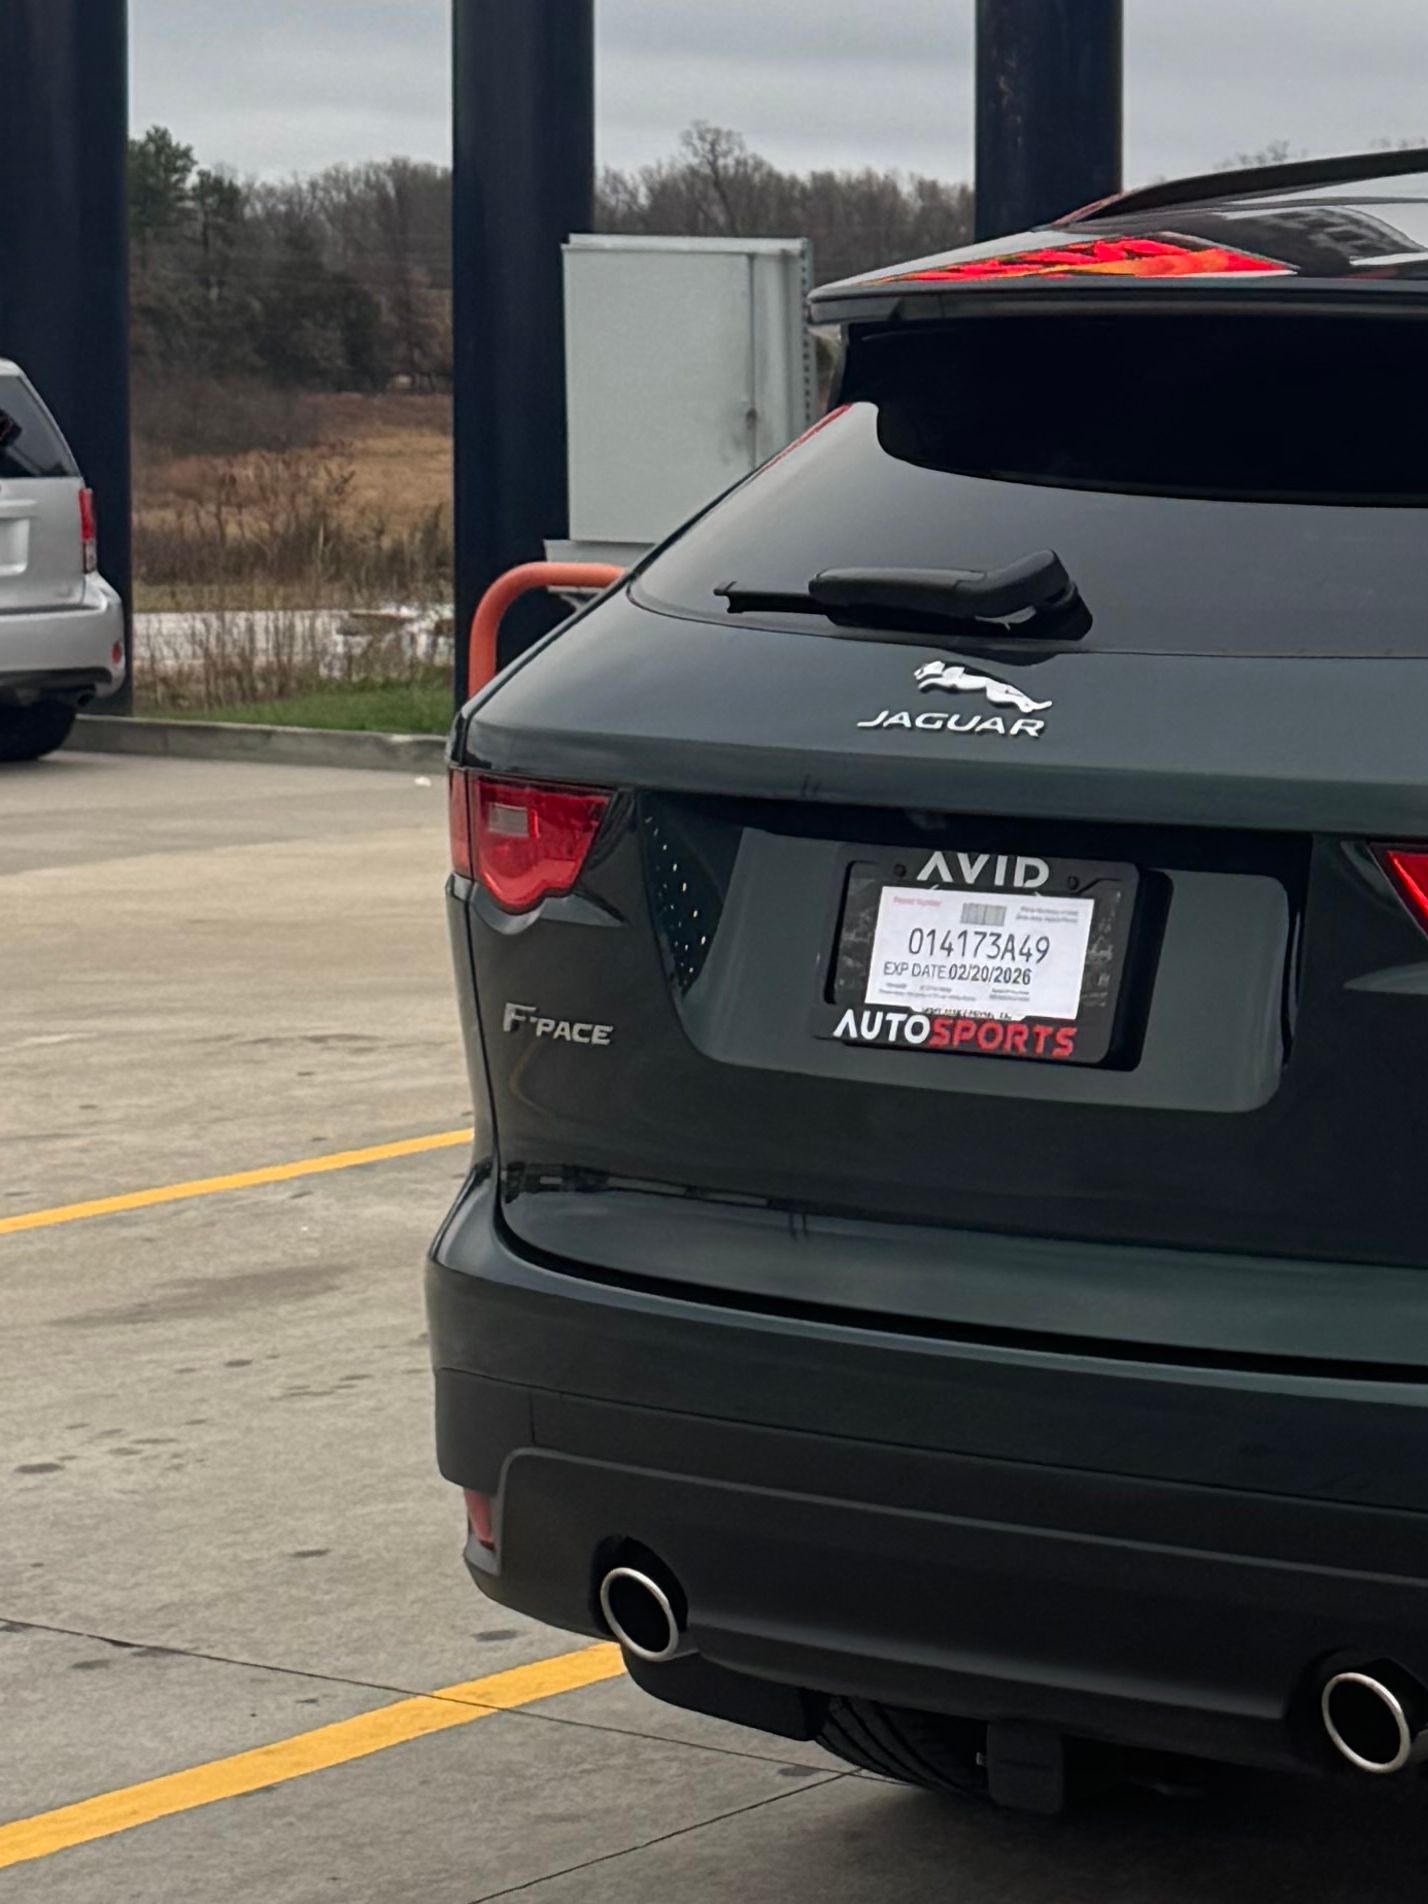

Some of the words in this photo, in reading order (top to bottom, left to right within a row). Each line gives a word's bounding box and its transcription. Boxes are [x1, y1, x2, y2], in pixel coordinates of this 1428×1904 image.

[857, 710, 1045, 737] JAGUAR
[916, 850, 1050, 888] AVID
[908, 927, 1050, 965] 014173A49
[883, 961, 909, 976] EXP
[503, 1002, 614, 1046] F-PACE
[833, 1009, 1078, 1057] AUTOSPORTS
